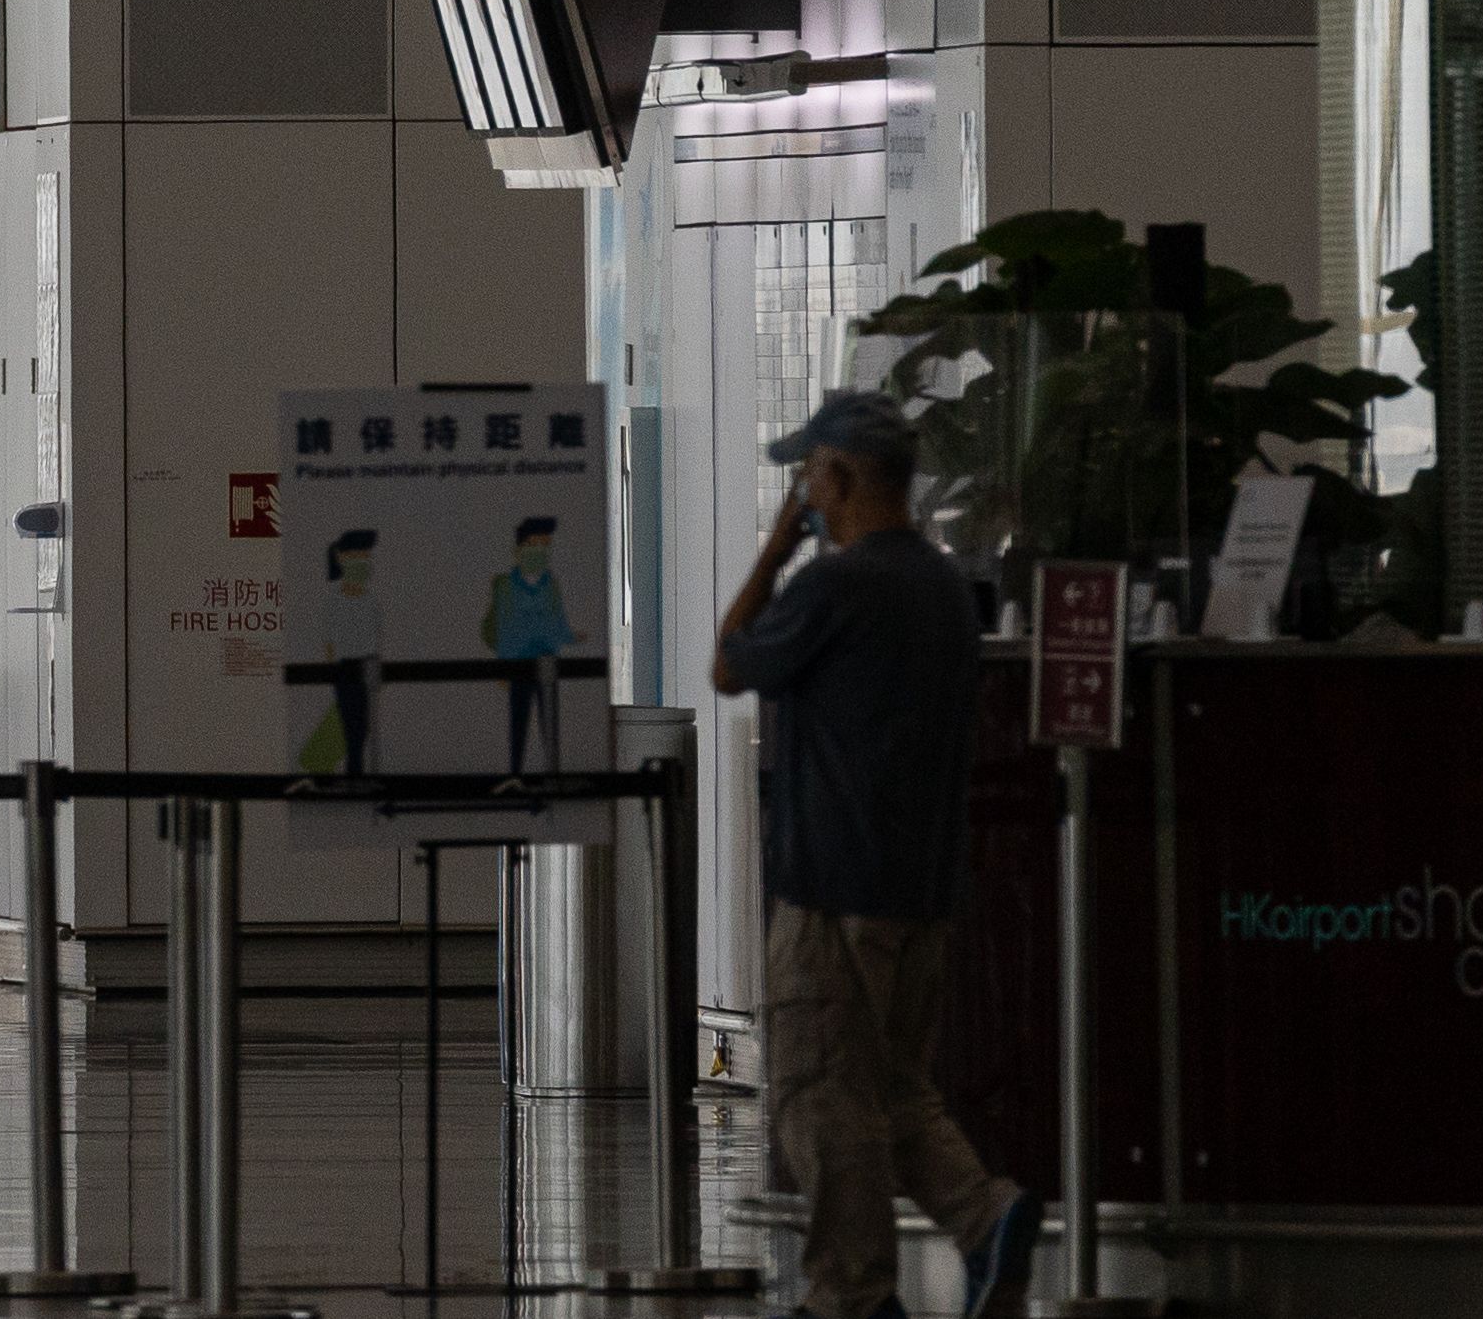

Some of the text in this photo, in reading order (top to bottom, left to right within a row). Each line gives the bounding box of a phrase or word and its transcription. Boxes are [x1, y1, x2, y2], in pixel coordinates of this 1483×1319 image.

[296, 413, 585, 454] 請保持距離
[296, 464, 352, 479] Please
[438, 461, 507, 480] physical
[513, 459, 586, 475] distance
[170, 612, 219, 631] FIRE
